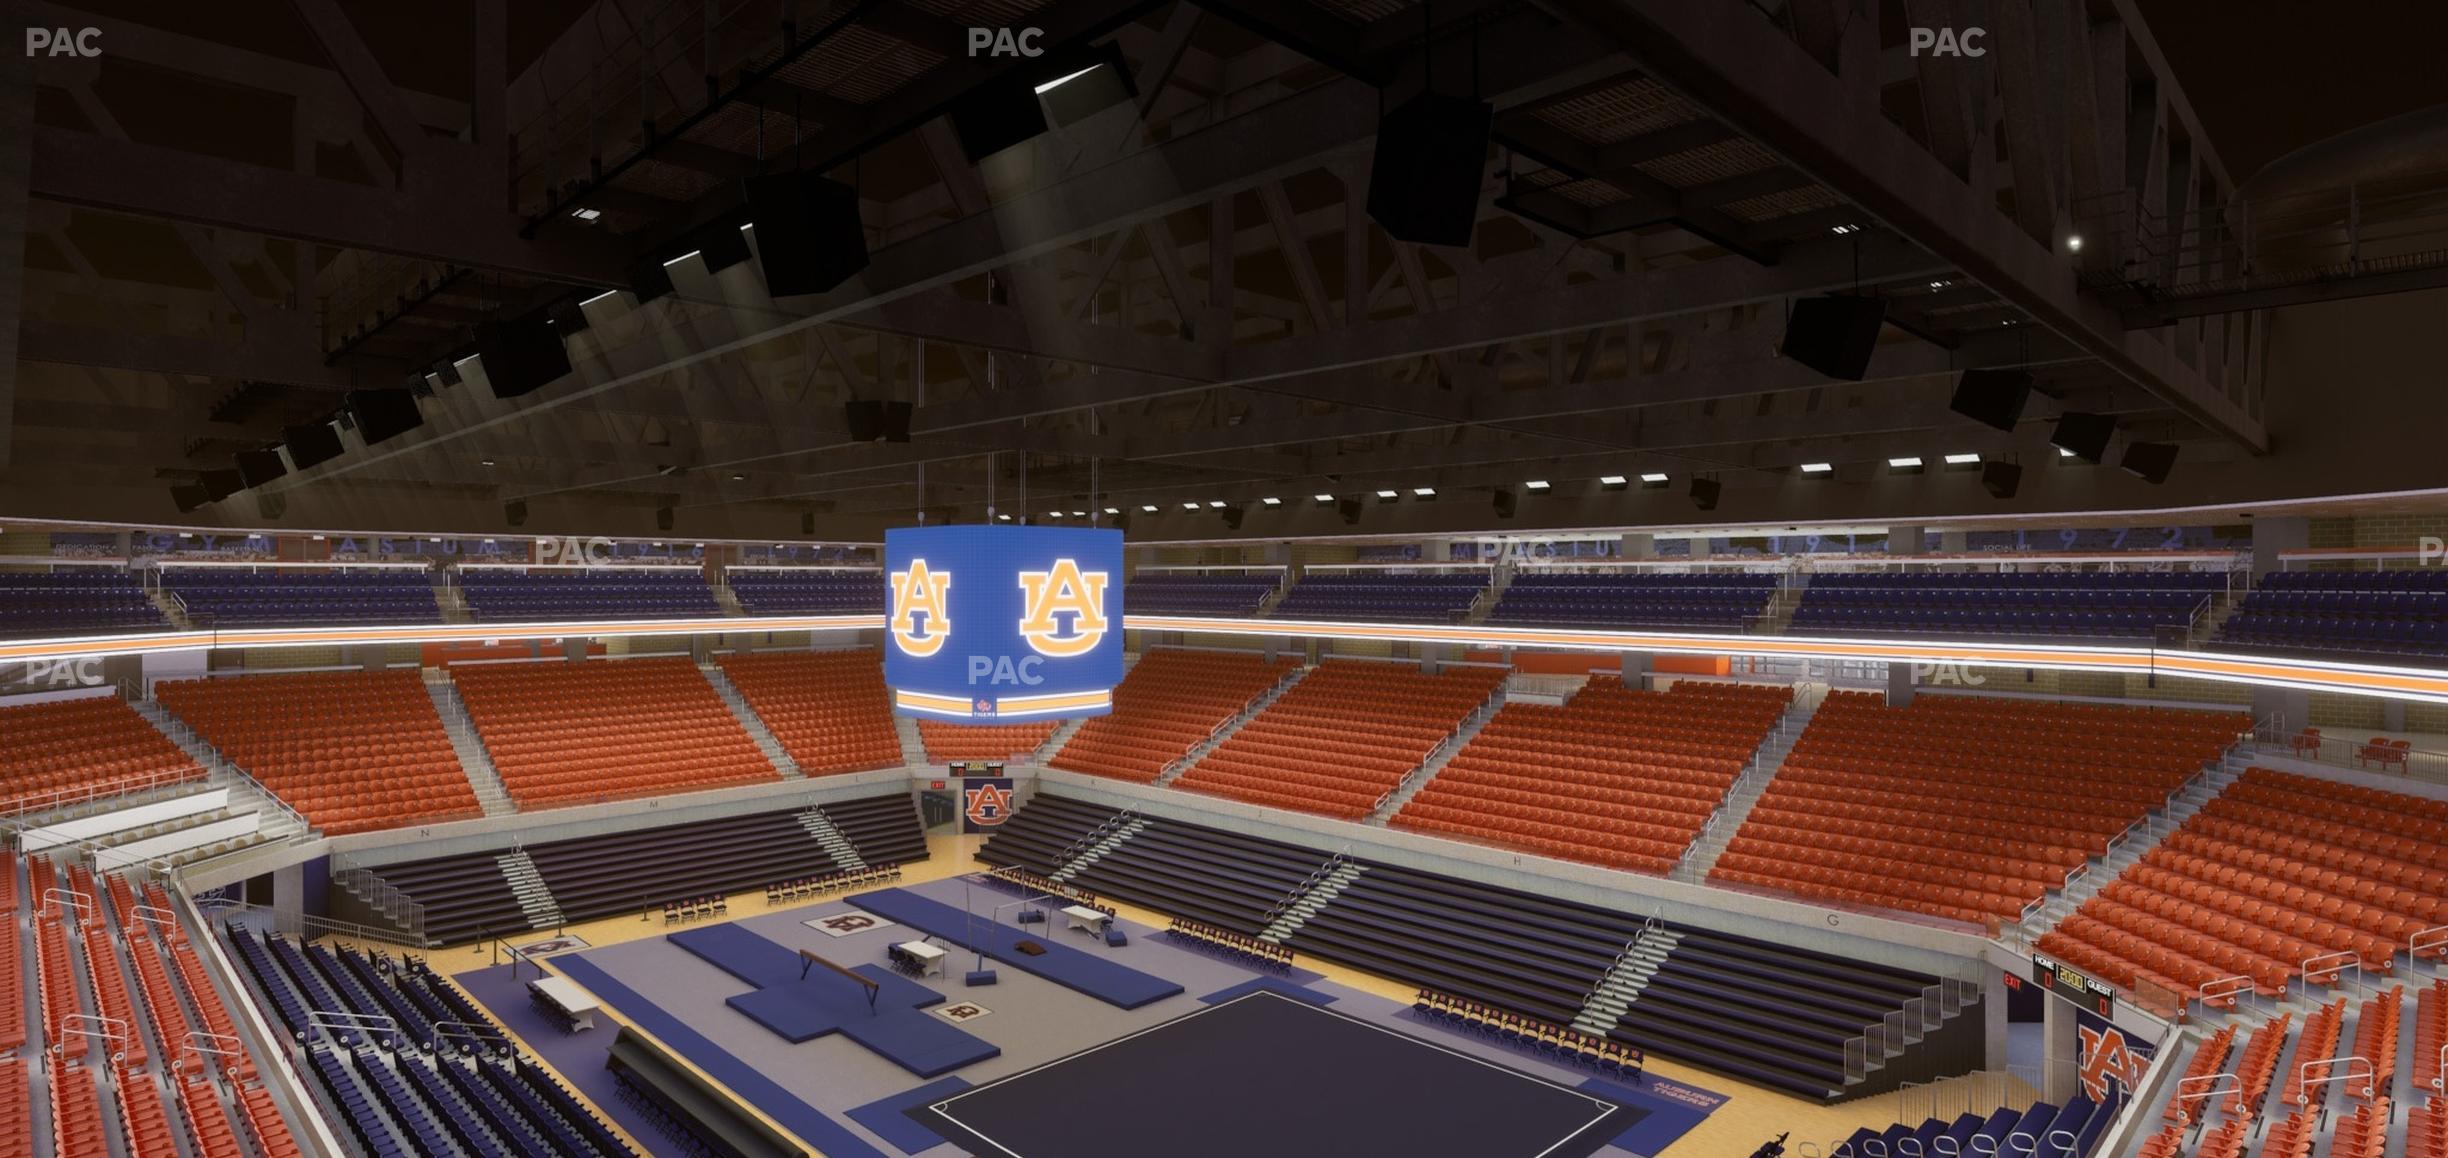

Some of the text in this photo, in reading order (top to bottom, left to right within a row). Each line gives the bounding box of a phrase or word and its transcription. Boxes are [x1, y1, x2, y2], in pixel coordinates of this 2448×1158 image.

[1514, 857, 1521, 865] H
[1827, 914, 1839, 926] G
[2003, 974, 2021, 990] EXIT
[2035, 955, 2054, 970] HOME
[2087, 980, 2111, 997] GUEST
